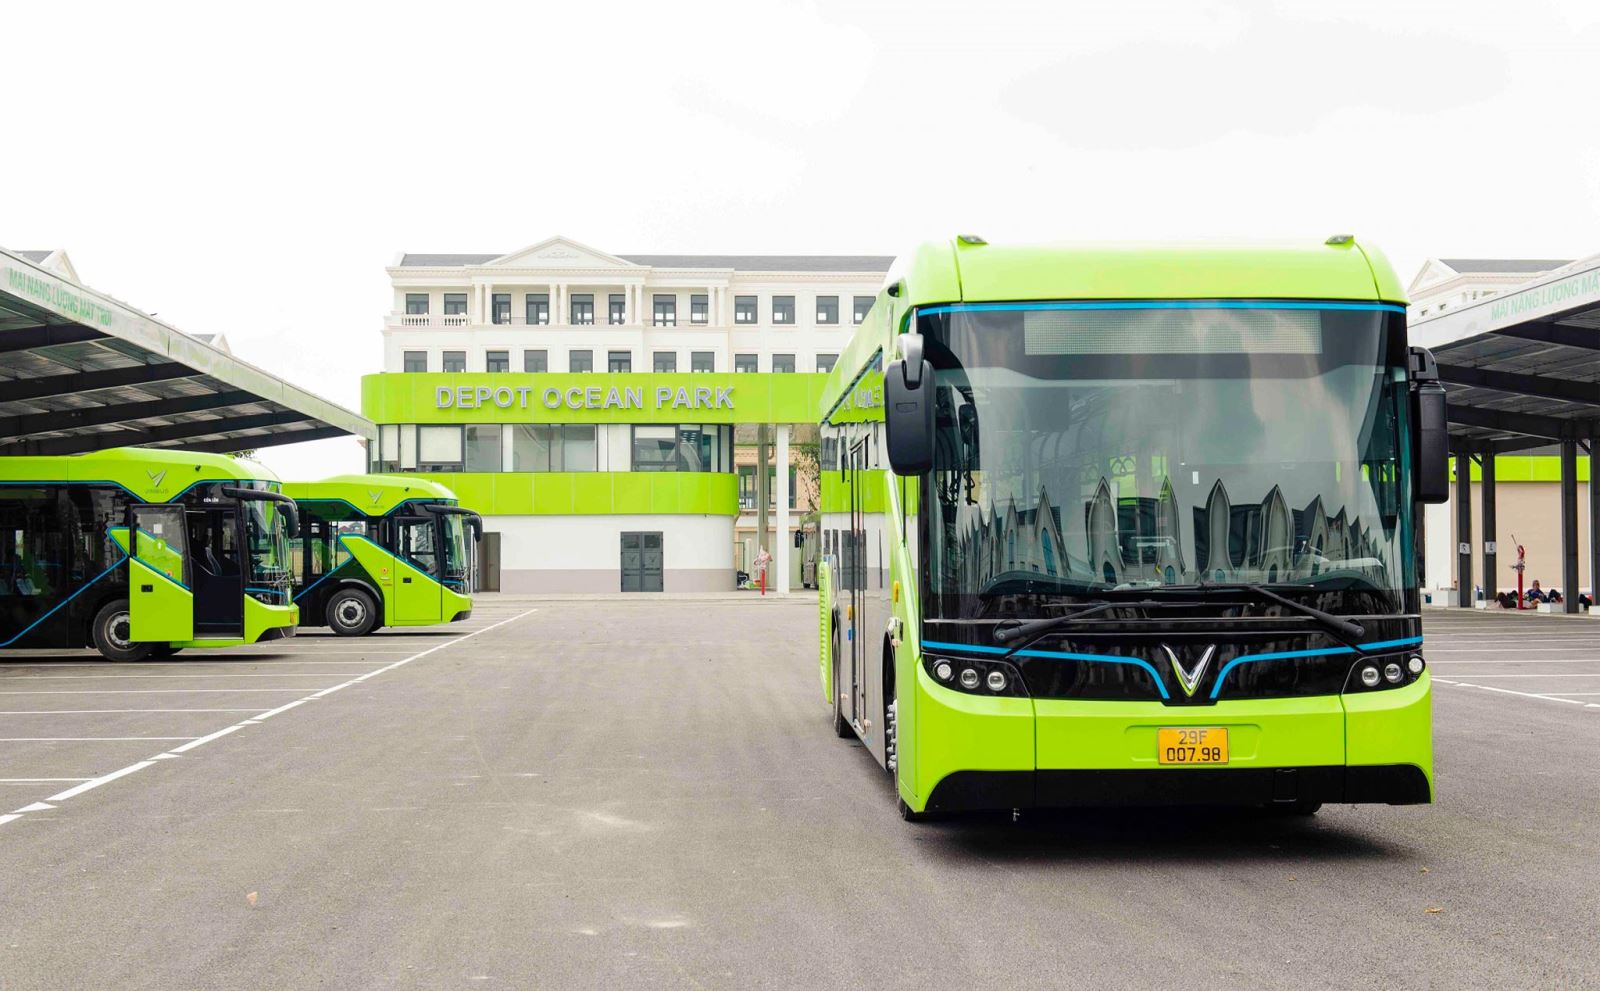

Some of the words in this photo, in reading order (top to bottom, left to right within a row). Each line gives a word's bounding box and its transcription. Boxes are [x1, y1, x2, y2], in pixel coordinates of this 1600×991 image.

[436, 386, 532, 409] DEPOT
[542, 386, 643, 409] OCEAN
[656, 386, 735, 409] PARK
[1178, 730, 1208, 745] 29F
[1166, 747, 1221, 762] 007.98
